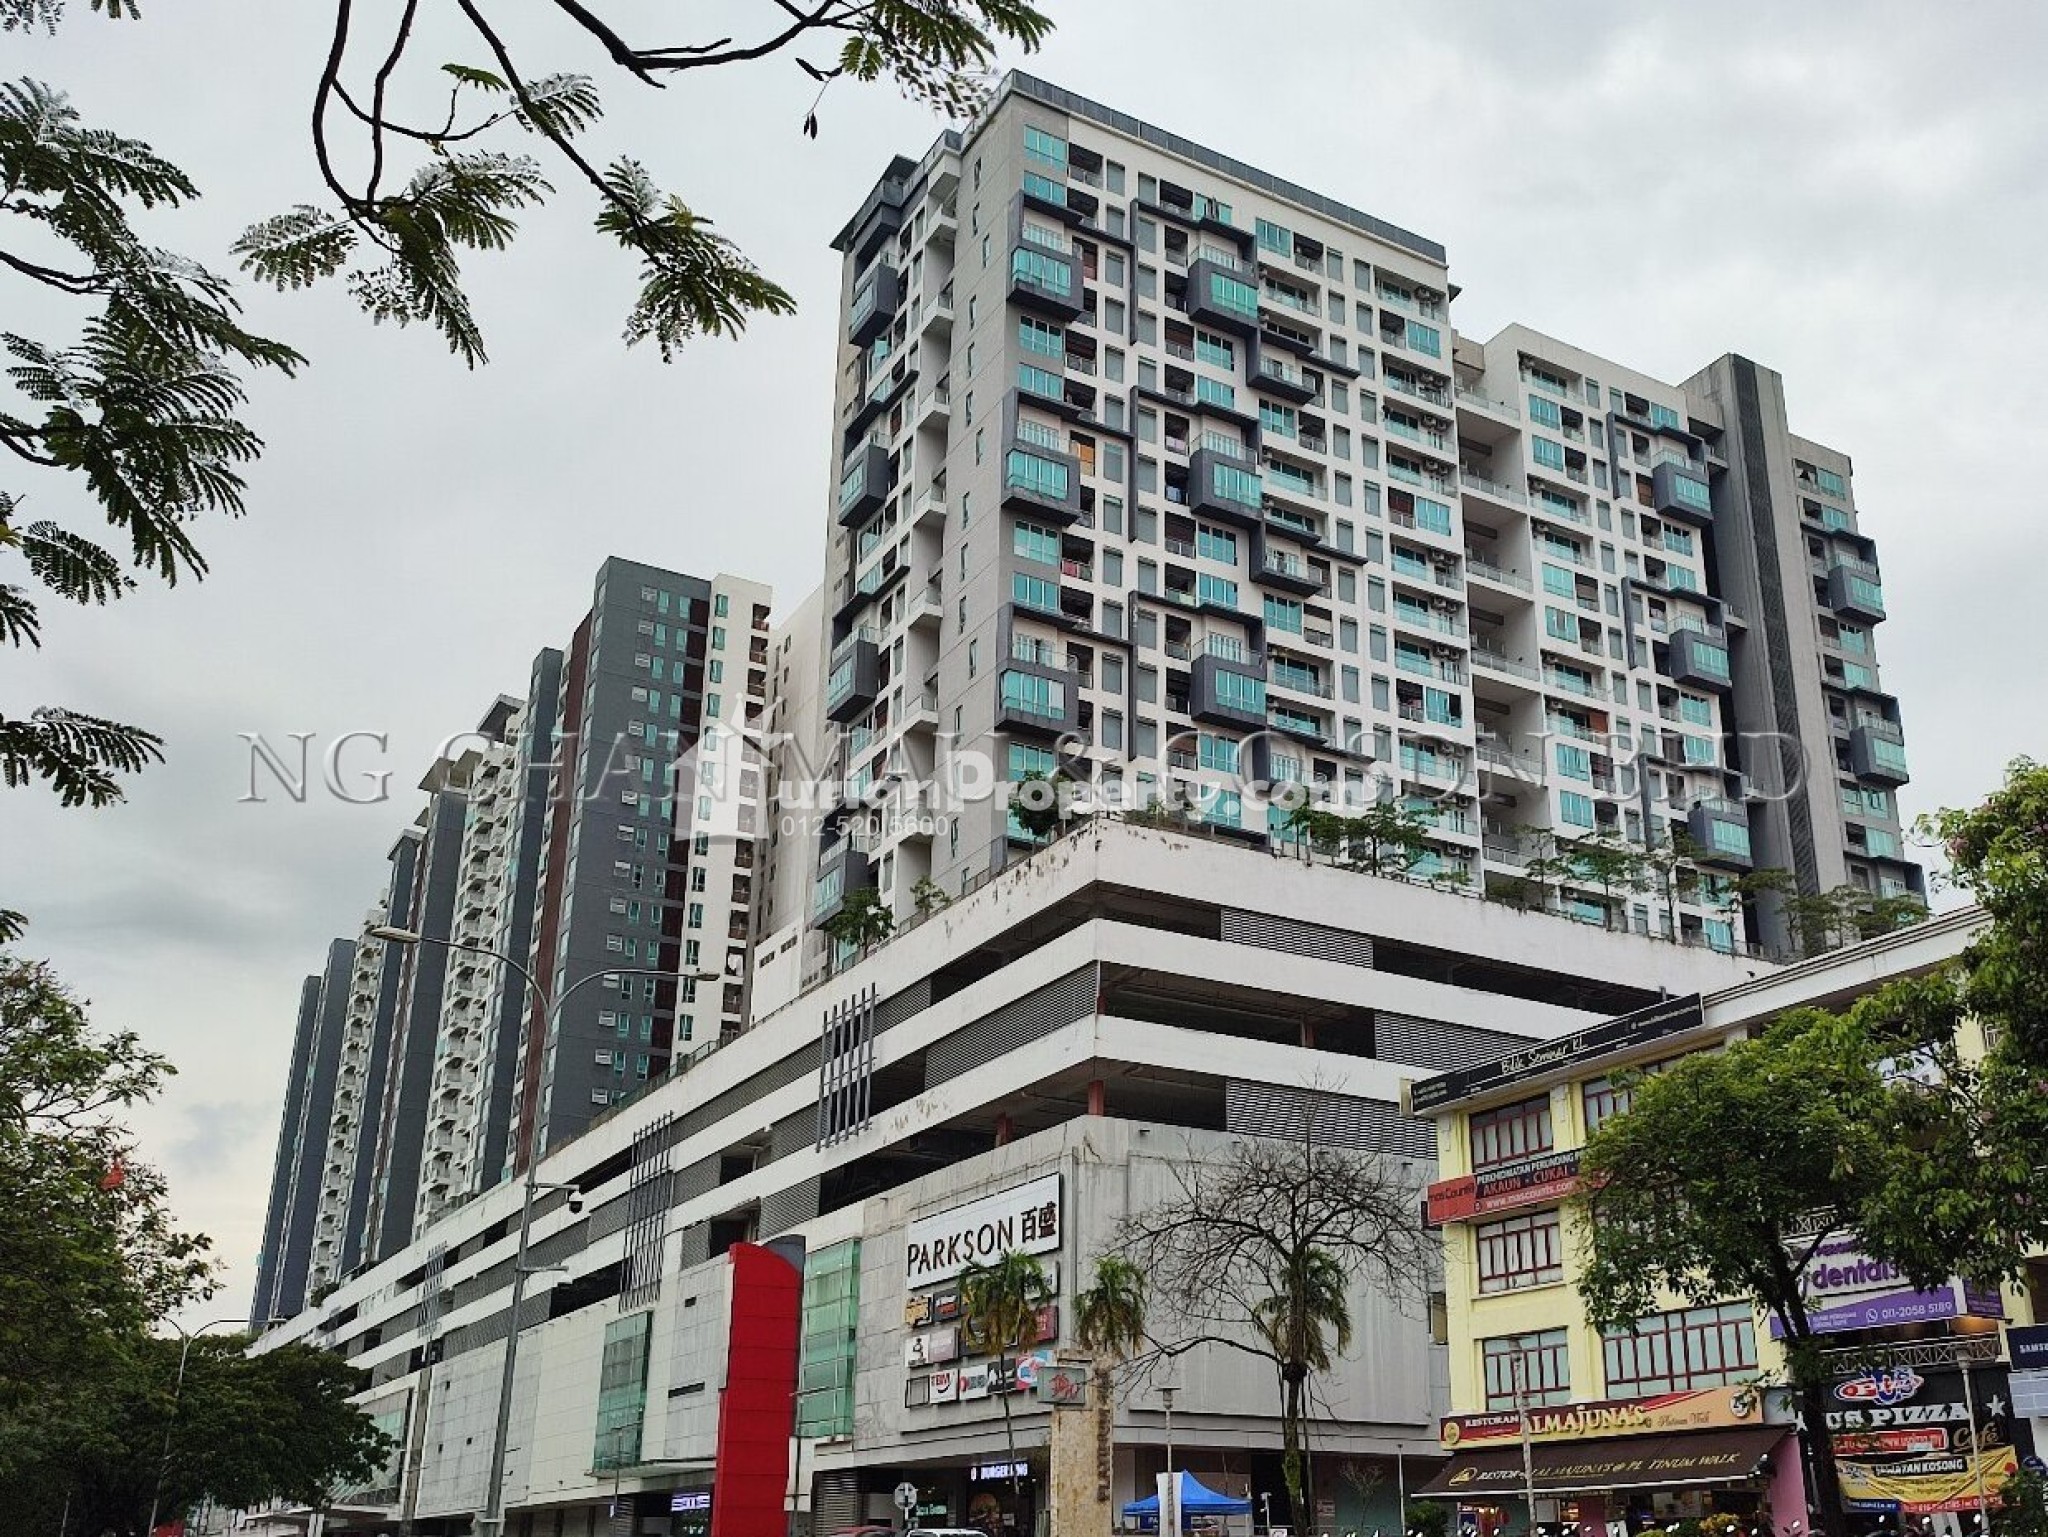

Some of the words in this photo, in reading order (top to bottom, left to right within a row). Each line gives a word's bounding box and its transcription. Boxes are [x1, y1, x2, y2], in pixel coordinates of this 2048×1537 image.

[1531, 1153, 1574, 1172] PERUNDING
[1483, 1176, 1521, 1196] AKAUN
[1533, 1166, 1569, 1185] CUKAI
[1021, 1201, 1057, 1243] 百盛
[907, 1216, 1013, 1278] PARKSON
[1465, 1415, 1519, 1428] RESTORAN
[1868, 1402, 1970, 1428] PIZZA
[1698, 1452, 1741, 1465] WALK
[1922, 1459, 1963, 1476] KOSONG
